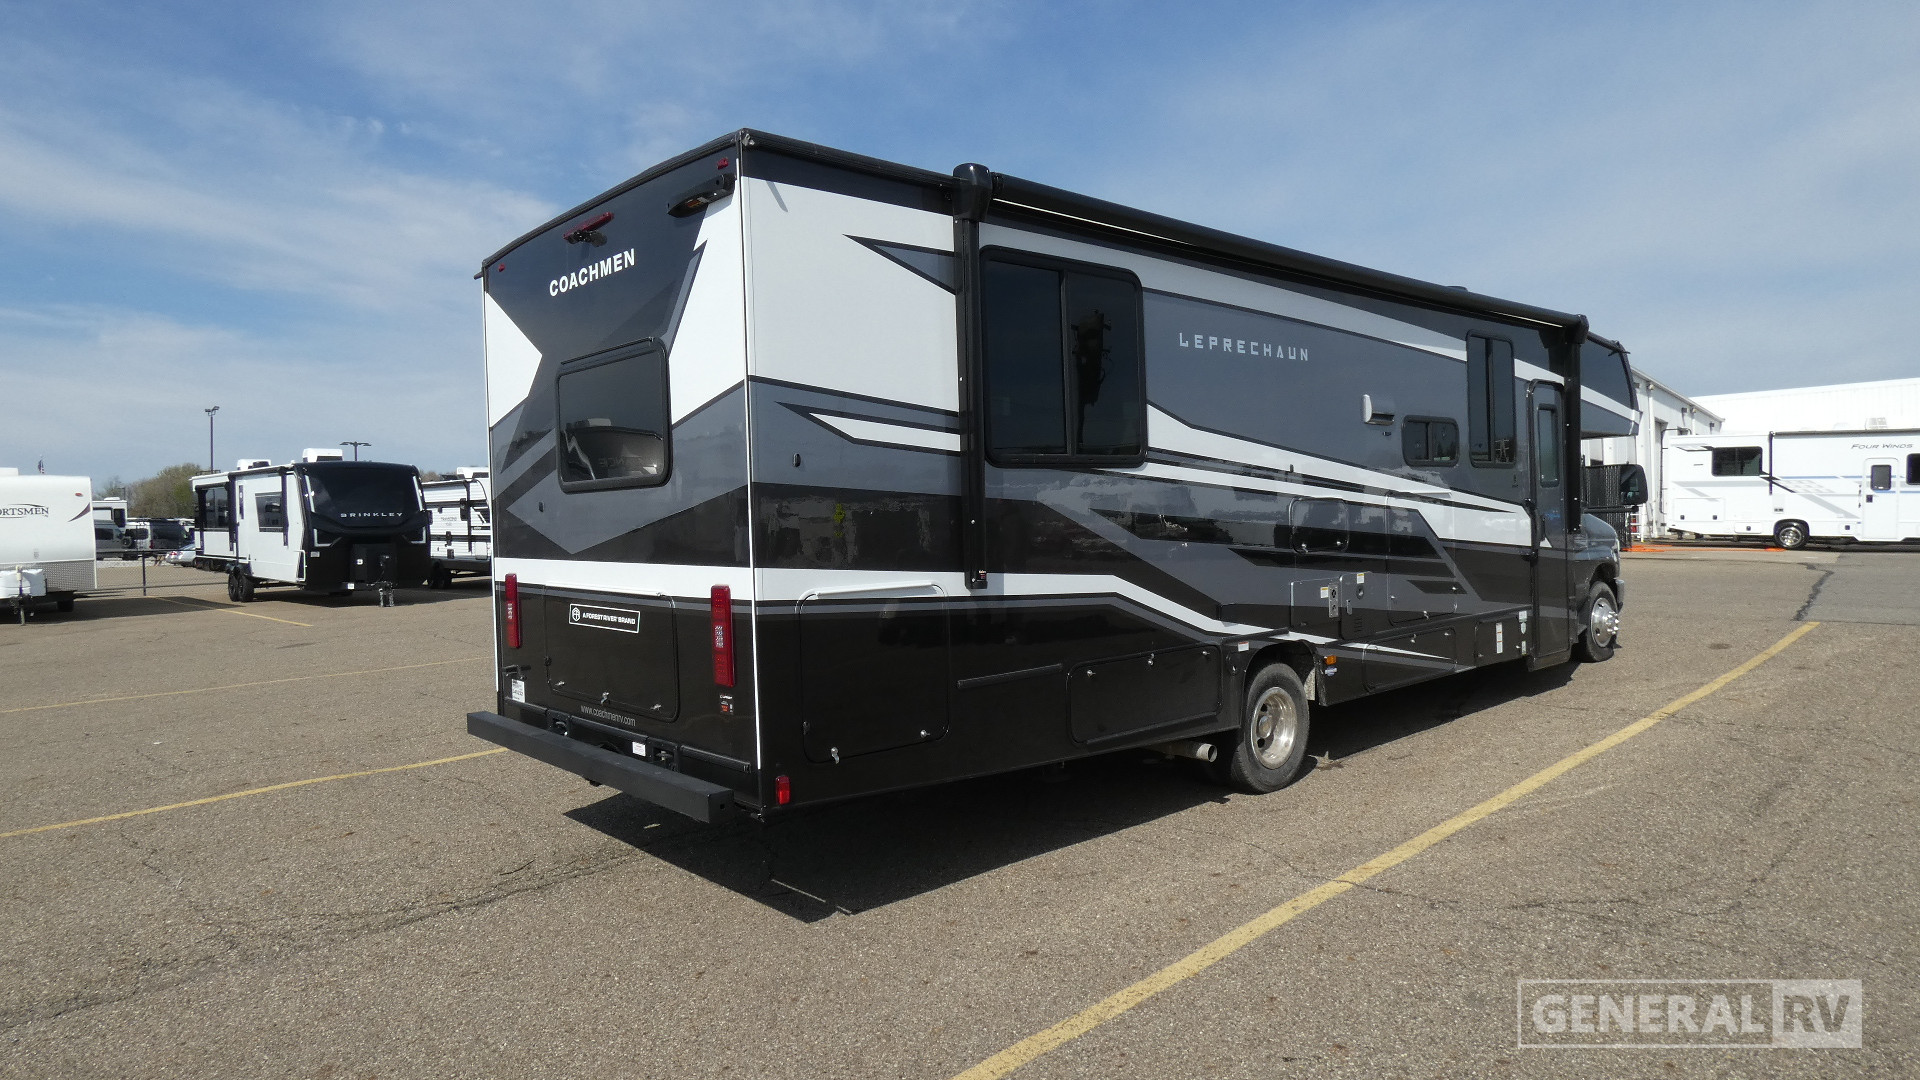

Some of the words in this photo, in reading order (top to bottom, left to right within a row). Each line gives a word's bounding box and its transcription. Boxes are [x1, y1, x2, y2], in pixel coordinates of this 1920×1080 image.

[549, 248, 635, 297] COACHMEN
[1179, 332, 1308, 361] LEPRECHAUN
[586, 612, 603, 621] FOREST
[618, 616, 636, 625] BRAND
